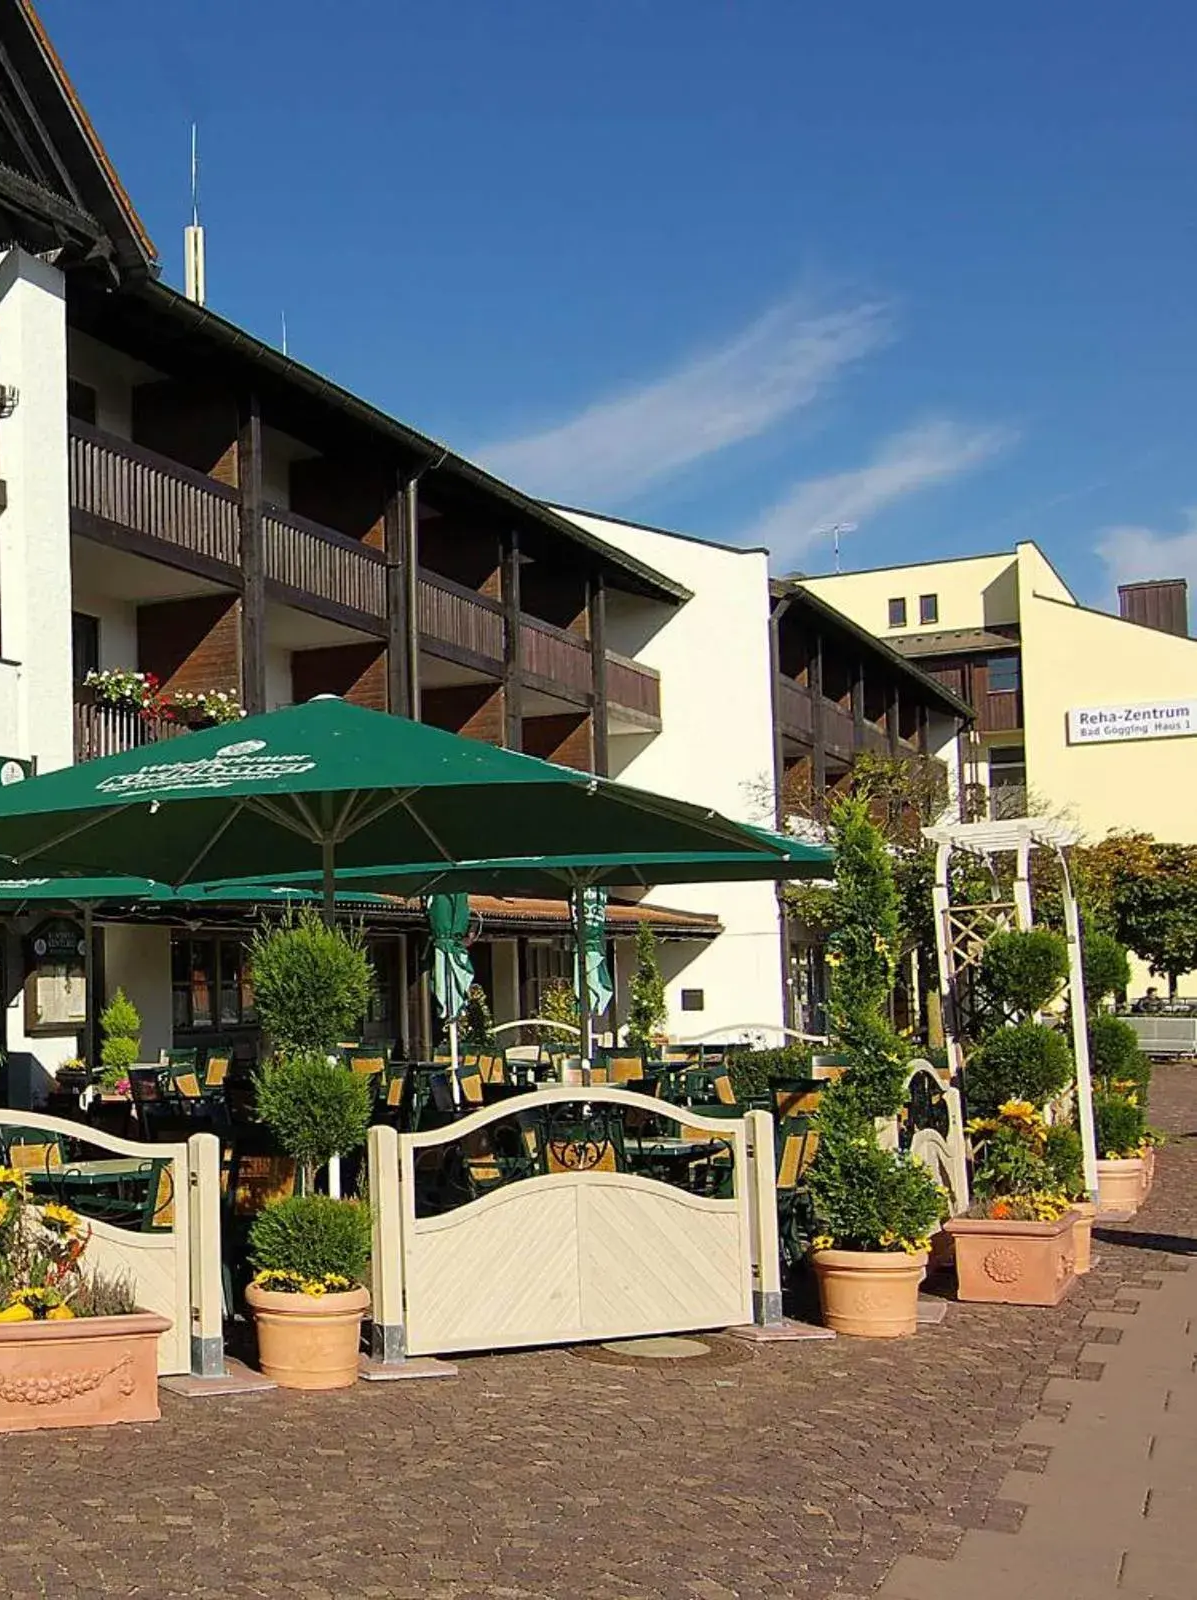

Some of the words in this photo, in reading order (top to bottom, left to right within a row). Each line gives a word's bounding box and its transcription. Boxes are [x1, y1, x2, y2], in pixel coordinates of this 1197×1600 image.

[1080, 707, 1190, 724] Reha-Zentrum
[1081, 727, 1101, 737] Bad
[1155, 721, 1181, 731] Haus
[1185, 719, 1191, 729] 1
